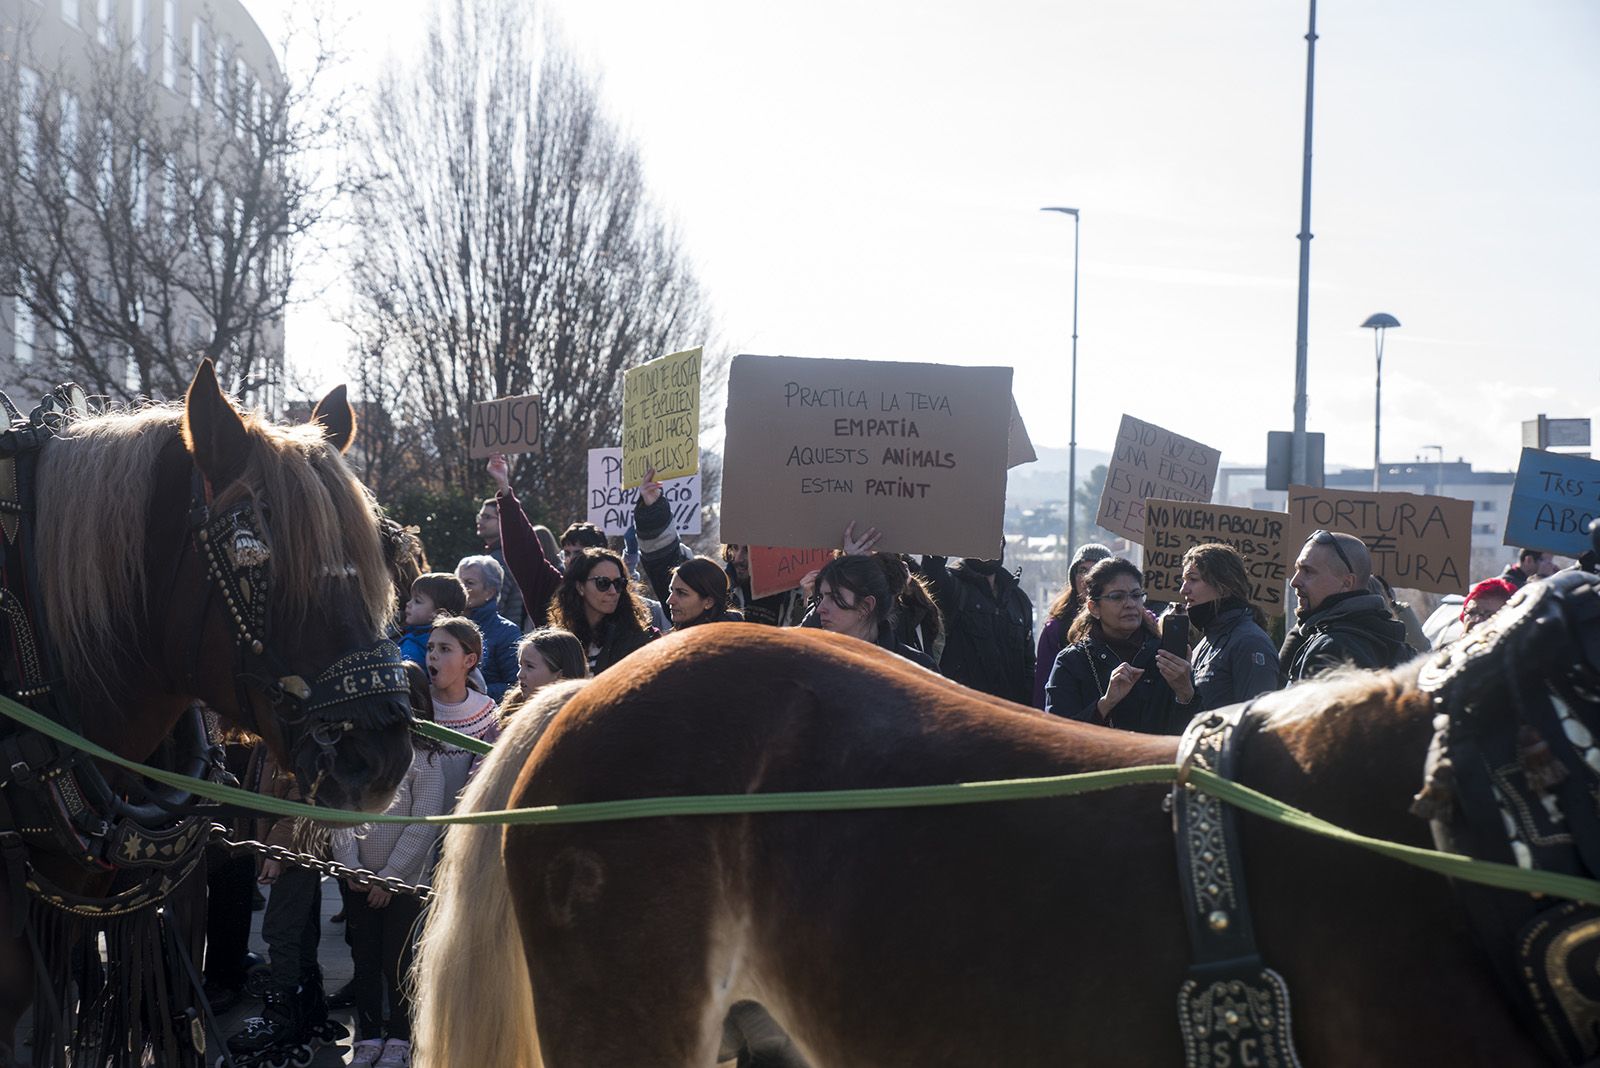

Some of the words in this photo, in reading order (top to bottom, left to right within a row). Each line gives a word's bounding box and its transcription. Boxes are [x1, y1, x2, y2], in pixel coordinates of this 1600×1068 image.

[671, 354, 700, 388] GUSTA
[652, 388, 694, 417] EXPLOTEN
[784, 381, 869, 410] PRACTICA
[881, 391, 900, 412] LA
[904, 391, 952, 416] TEVA
[472, 401, 539, 448] ABUSO
[665, 412, 692, 438] HACES
[655, 437, 694, 473] ELLXS?
[786, 446, 869, 466] AQUESTS
[882, 447, 956, 469] ANIMALS
[1121, 420, 1157, 447] ESTO
[1162, 434, 1184, 457] NO
[1189, 446, 1208, 466] ES
[1110, 468, 1132, 494] ES
[1117, 441, 1148, 470] UNA
[1158, 456, 1208, 495] FIESTA
[1539, 471, 1584, 497] TRES
[801, 478, 853, 494] ESTAN
[865, 476, 931, 499] PATINT
[1104, 497, 1125, 520] DE
[1147, 505, 1169, 528] NO
[1172, 507, 1214, 531] VOLEM
[1218, 514, 1283, 539] ABOLIR
[1294, 495, 1450, 539] TORTURA
[1534, 503, 1591, 535] ABO
[1146, 549, 1182, 569] VOLE
[1371, 550, 1462, 588] TURA
[1144, 570, 1181, 592] PELS
